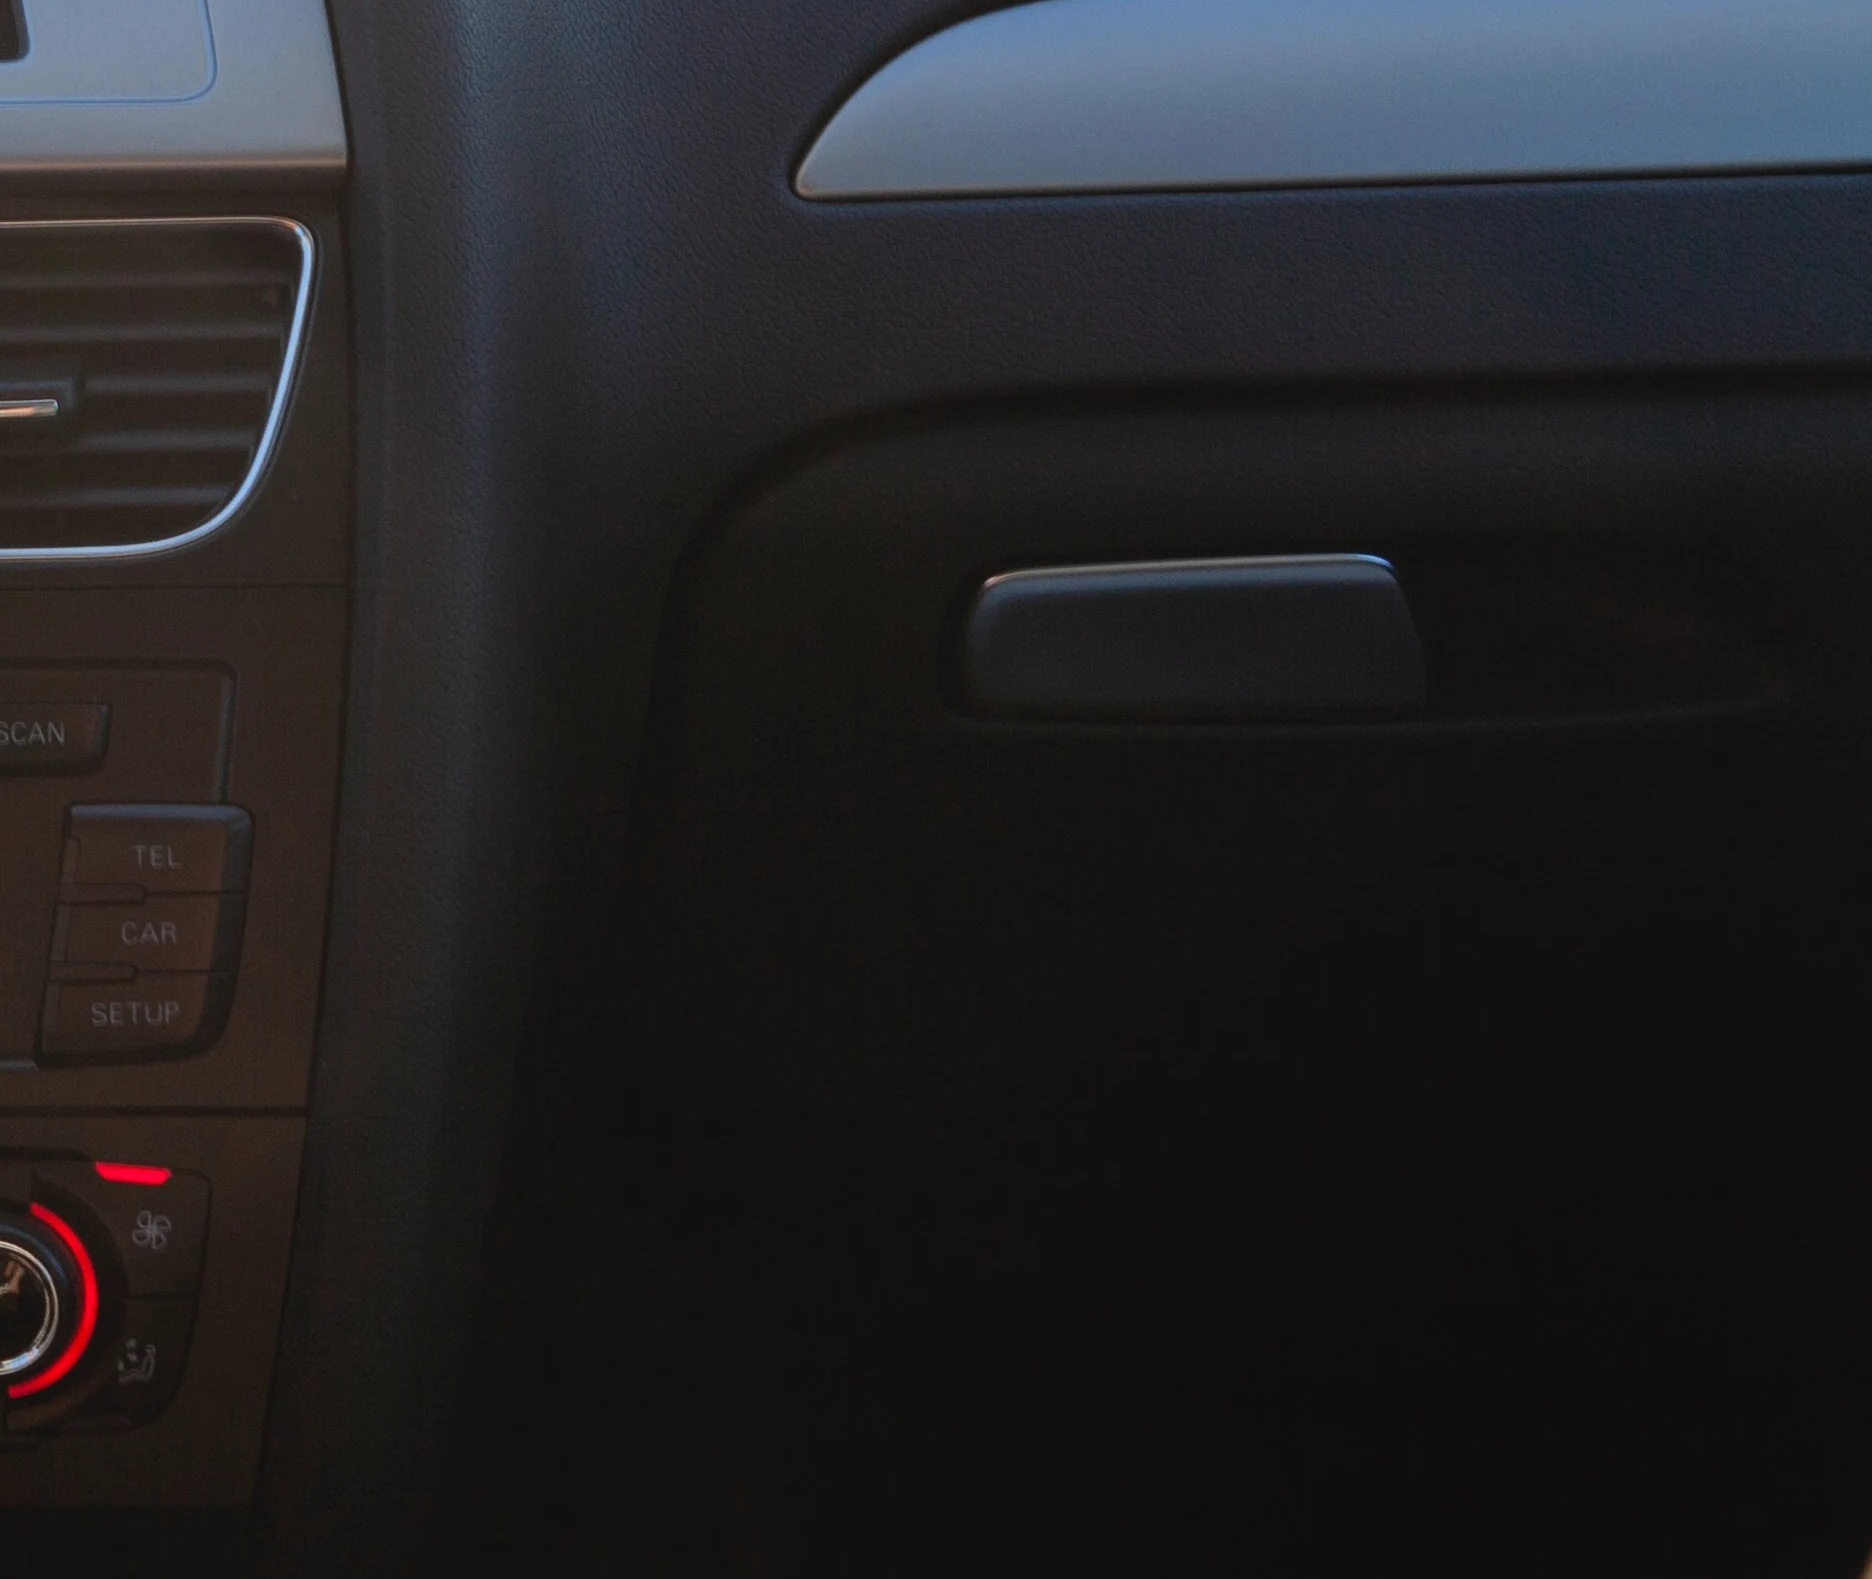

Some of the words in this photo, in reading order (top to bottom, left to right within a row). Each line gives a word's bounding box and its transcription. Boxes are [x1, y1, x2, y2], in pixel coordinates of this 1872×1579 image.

[133, 844, 180, 869] TEL
[121, 920, 178, 946] CAR
[91, 1001, 181, 1026] SETUP
